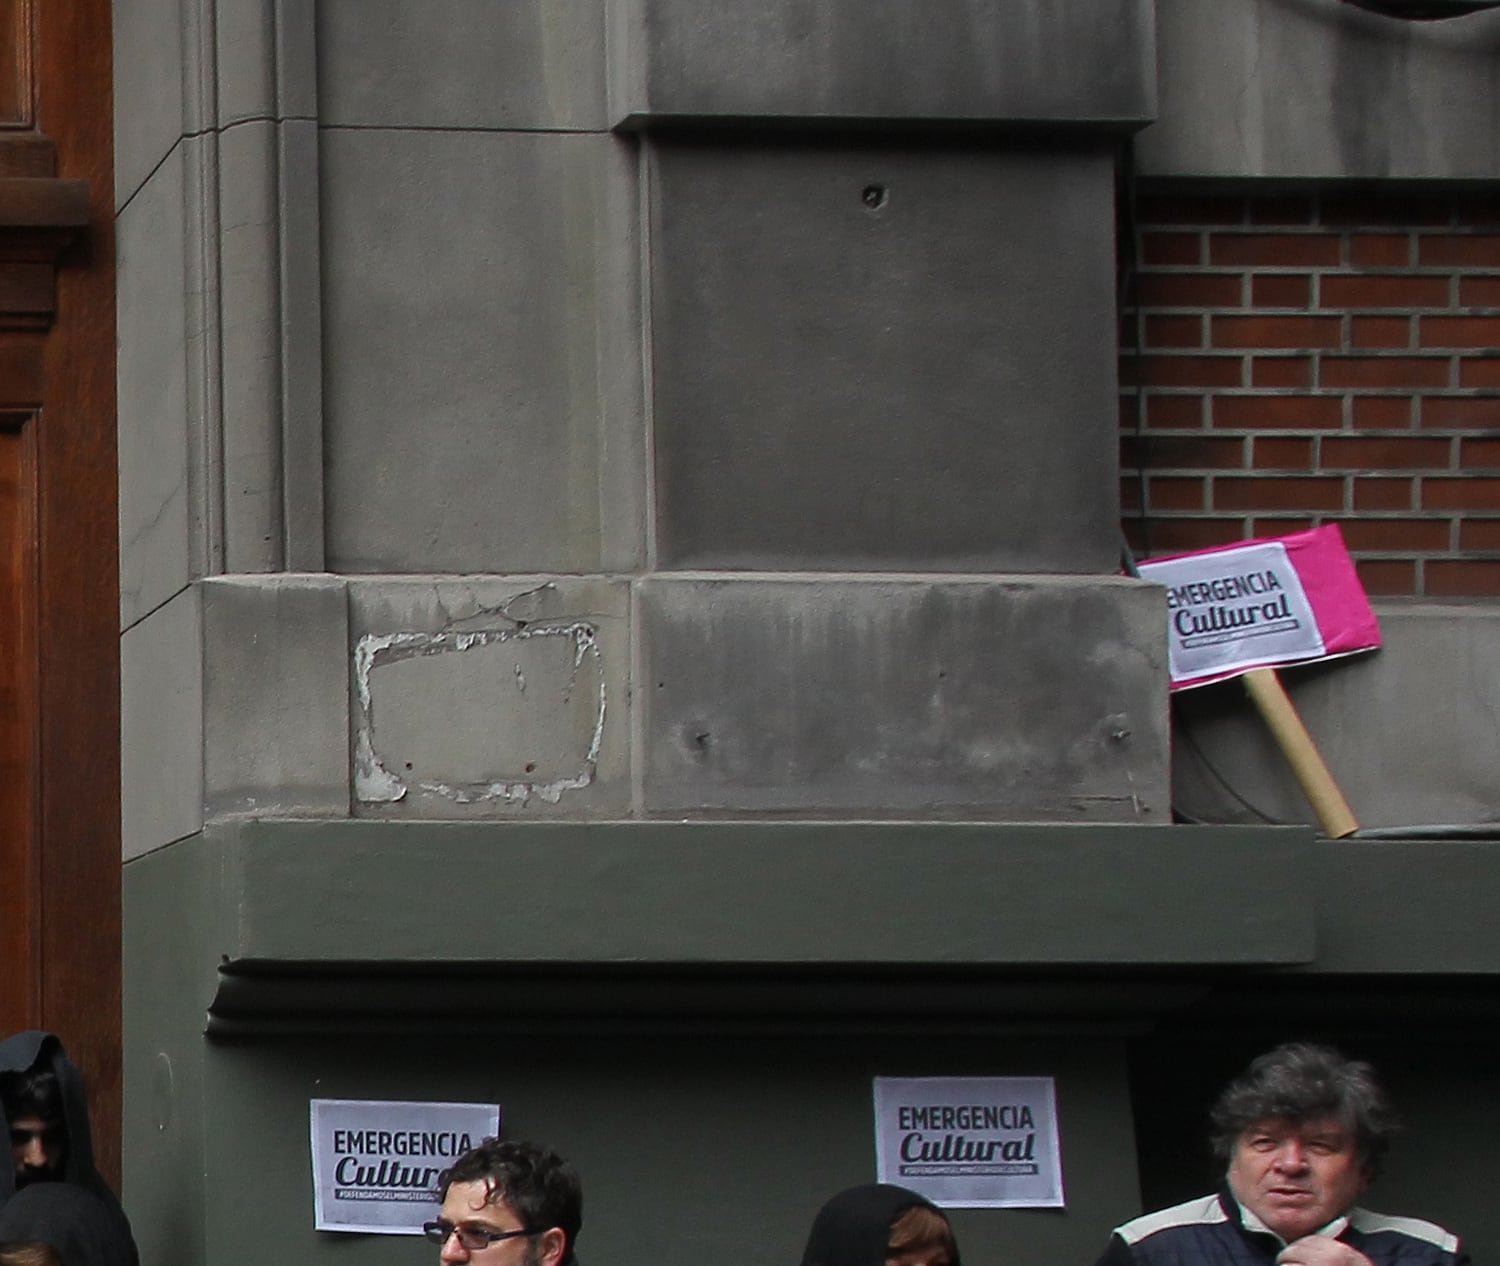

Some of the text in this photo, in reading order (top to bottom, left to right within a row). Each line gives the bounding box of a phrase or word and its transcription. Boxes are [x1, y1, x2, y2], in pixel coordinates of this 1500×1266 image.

[1174, 594, 1292, 637] Cultural
[898, 1105, 1034, 1131] EMERGENCIA
[334, 1130, 473, 1157] EMERGENCIA
[900, 1132, 1036, 1163] Cultural
